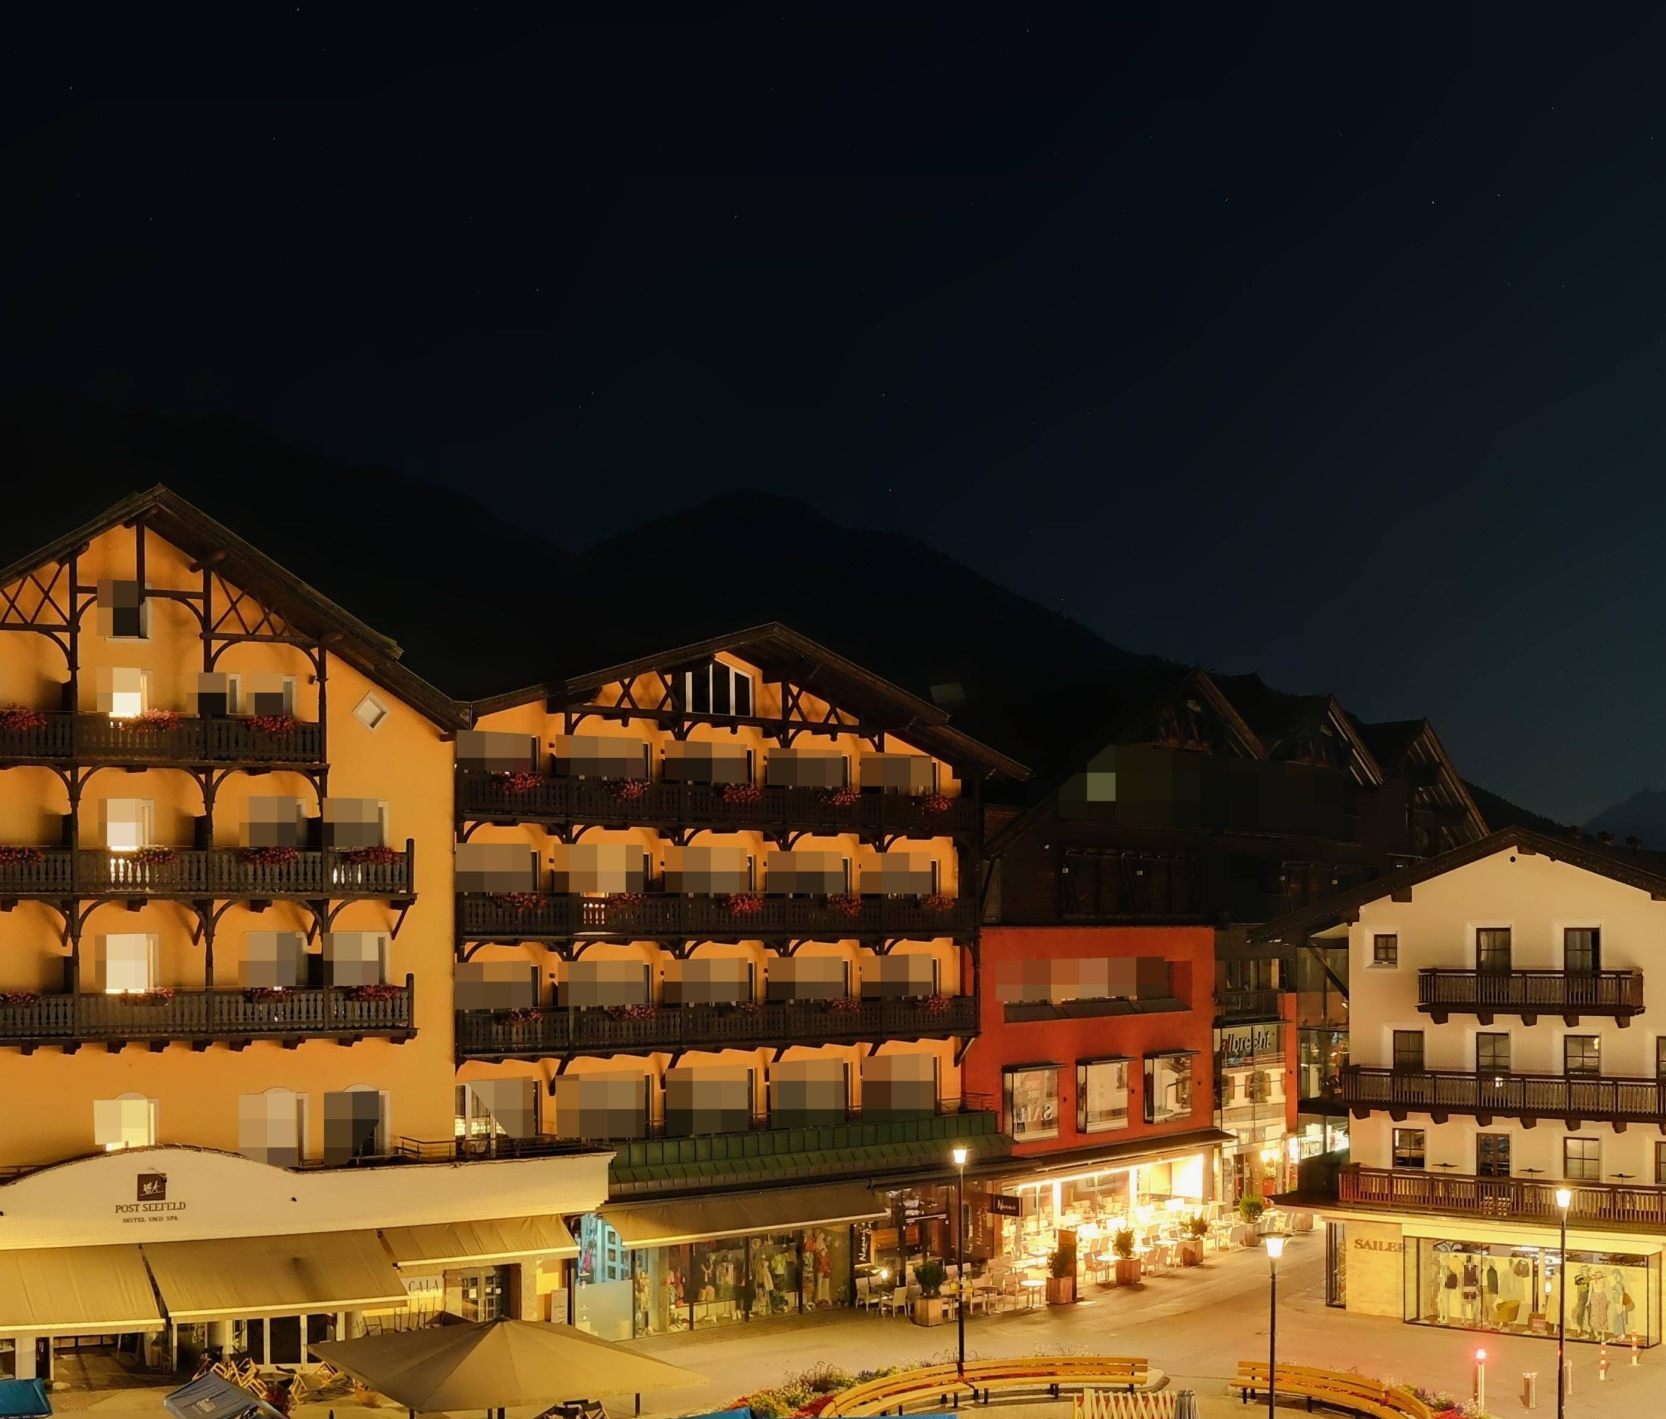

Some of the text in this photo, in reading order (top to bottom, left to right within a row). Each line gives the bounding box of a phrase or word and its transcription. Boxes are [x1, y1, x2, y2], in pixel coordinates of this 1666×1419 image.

[114, 1201, 187, 1215] POST SEEFELD
[122, 1216, 146, 1224] HOTEL
